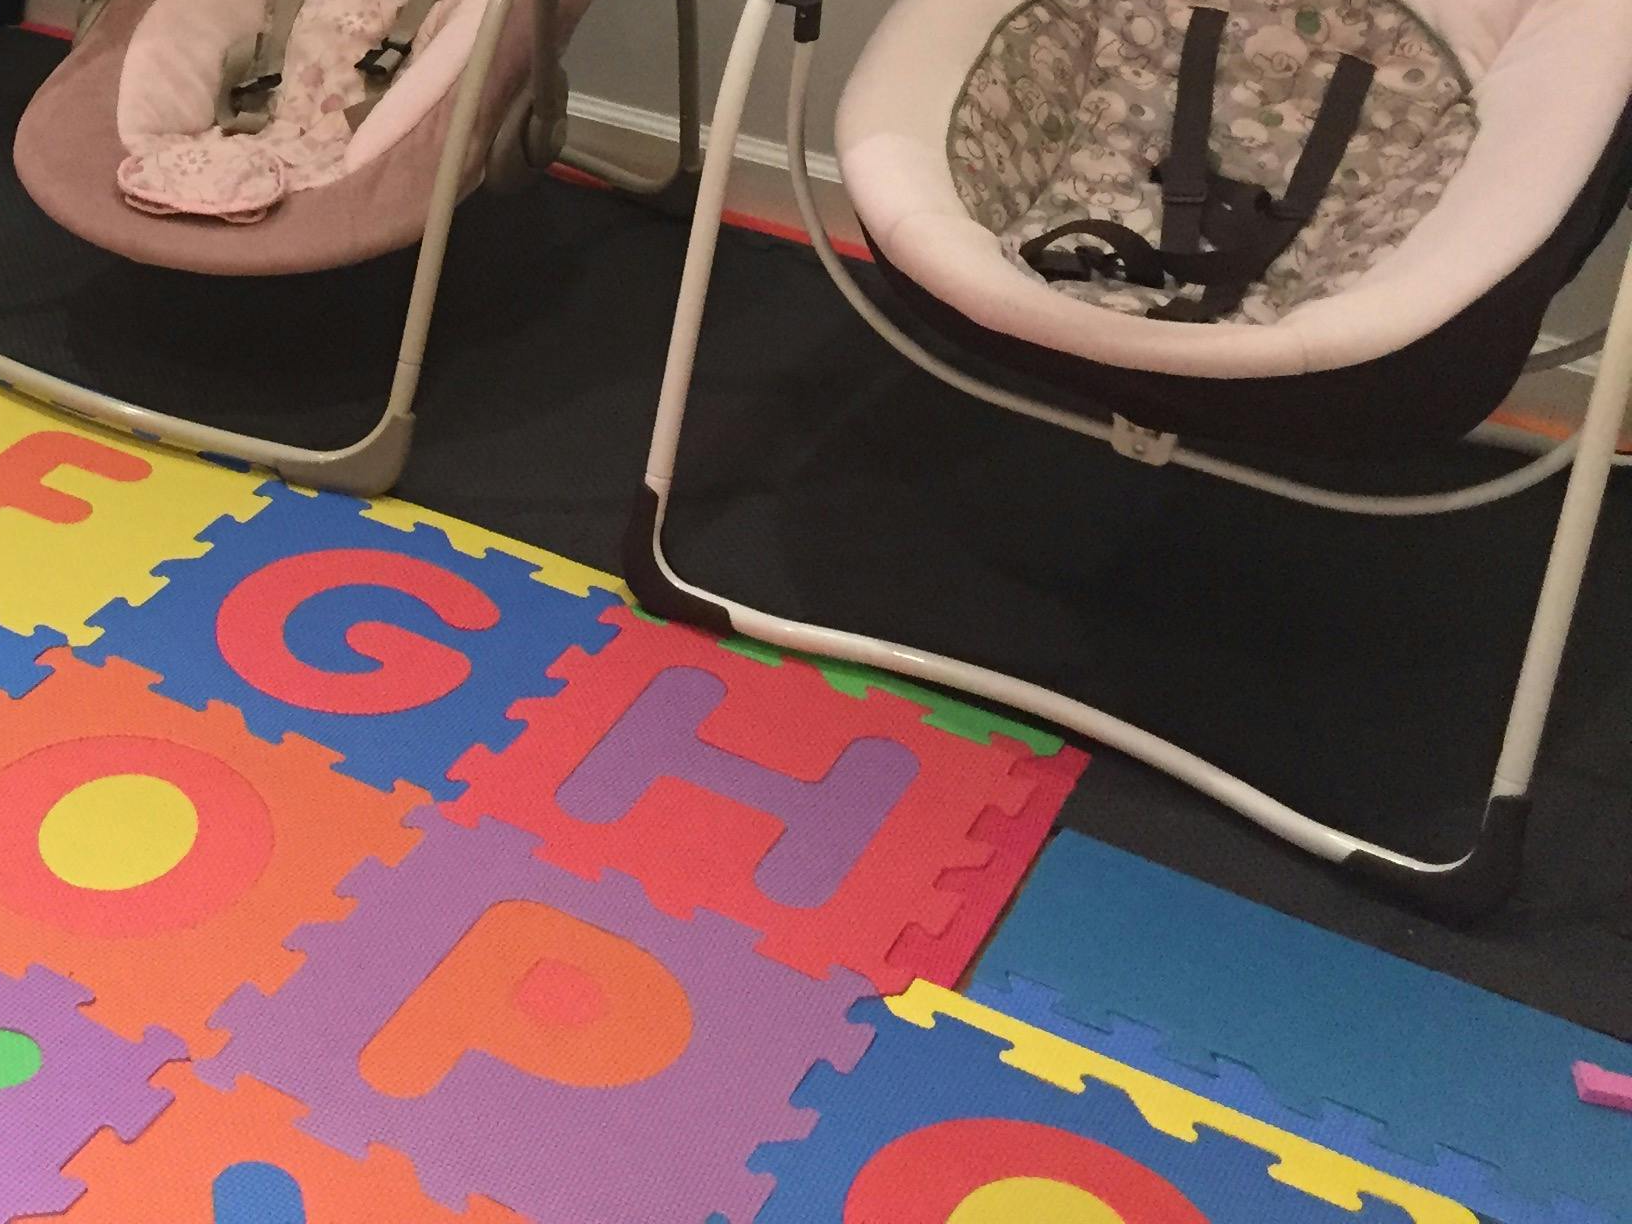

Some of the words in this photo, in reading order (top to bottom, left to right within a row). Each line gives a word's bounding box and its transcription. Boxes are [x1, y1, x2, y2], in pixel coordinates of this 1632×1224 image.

[216, 549, 501, 715] G
[555, 665, 921, 908] H
[358, 899, 694, 1098] P
